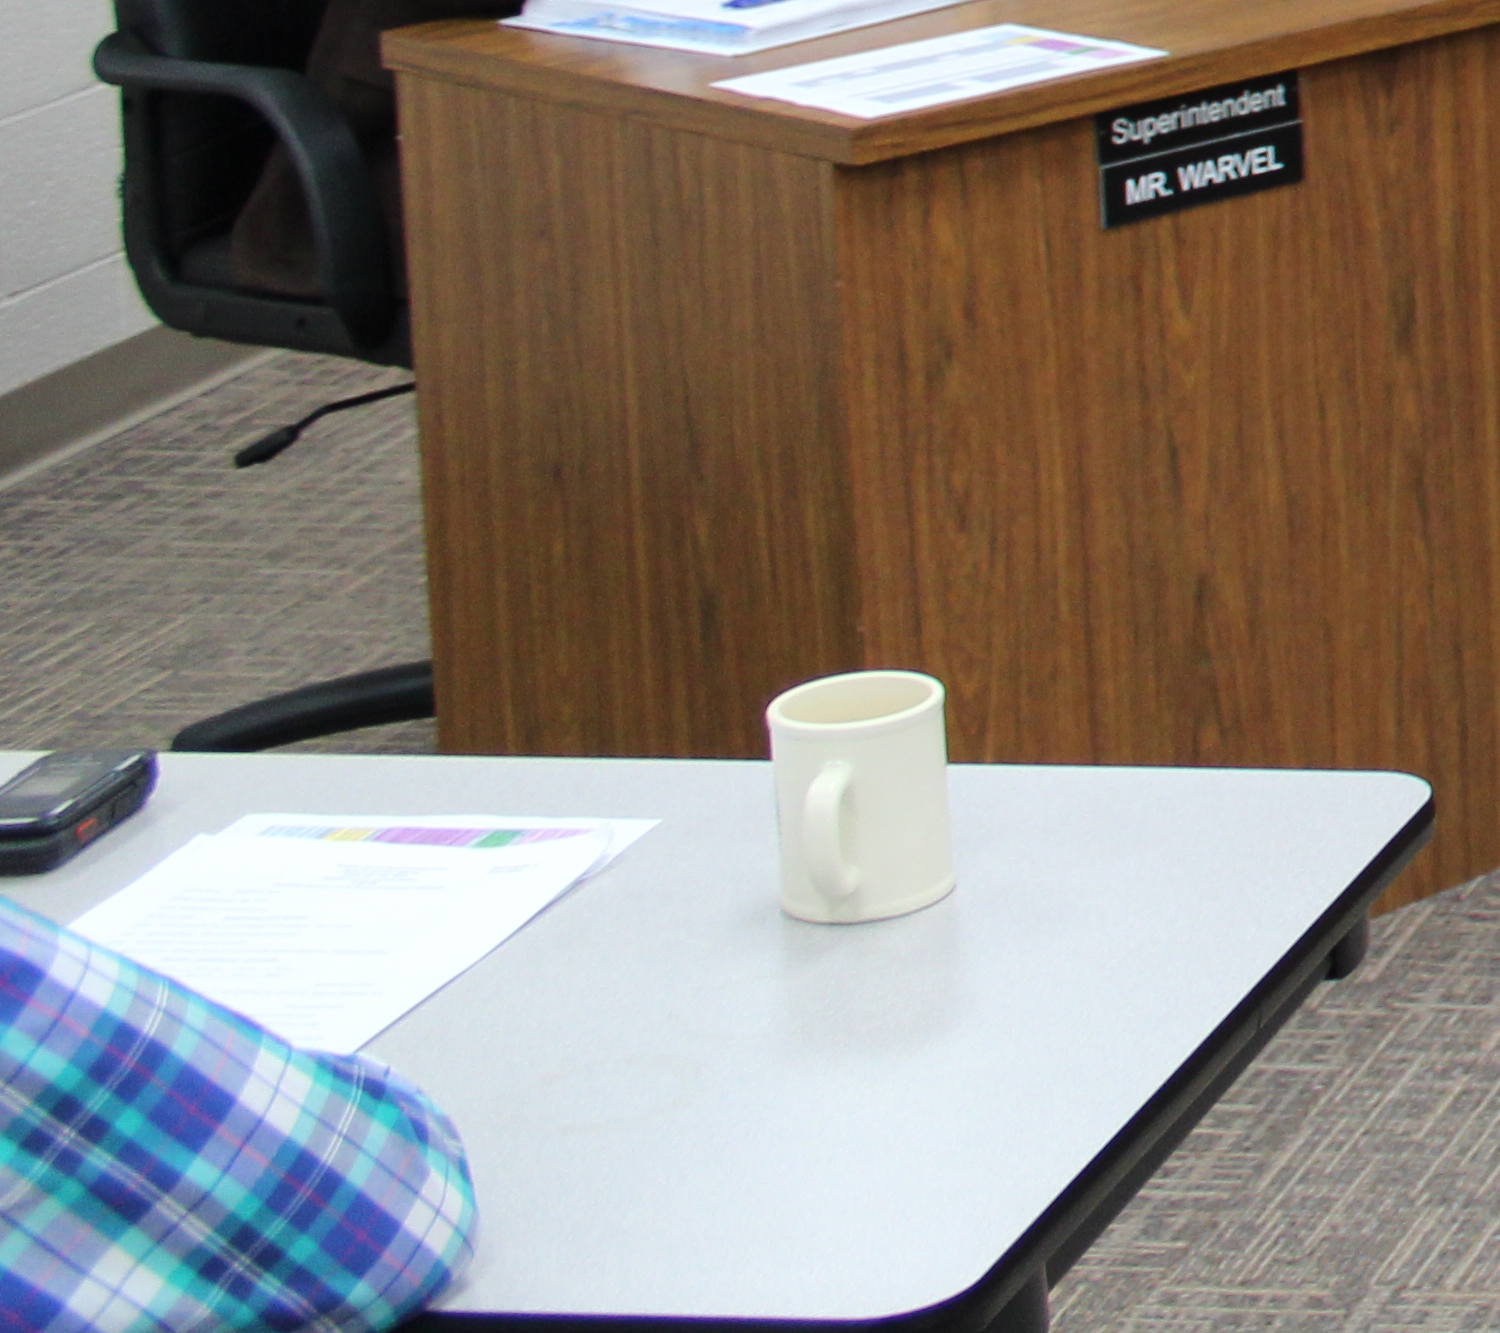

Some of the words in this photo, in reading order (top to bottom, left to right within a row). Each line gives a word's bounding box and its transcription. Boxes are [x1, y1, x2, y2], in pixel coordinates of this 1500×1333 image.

[1111, 84, 1287, 145] Superintendent
[1125, 171, 1174, 206] MR.
[1176, 145, 1285, 191] WARVEL
